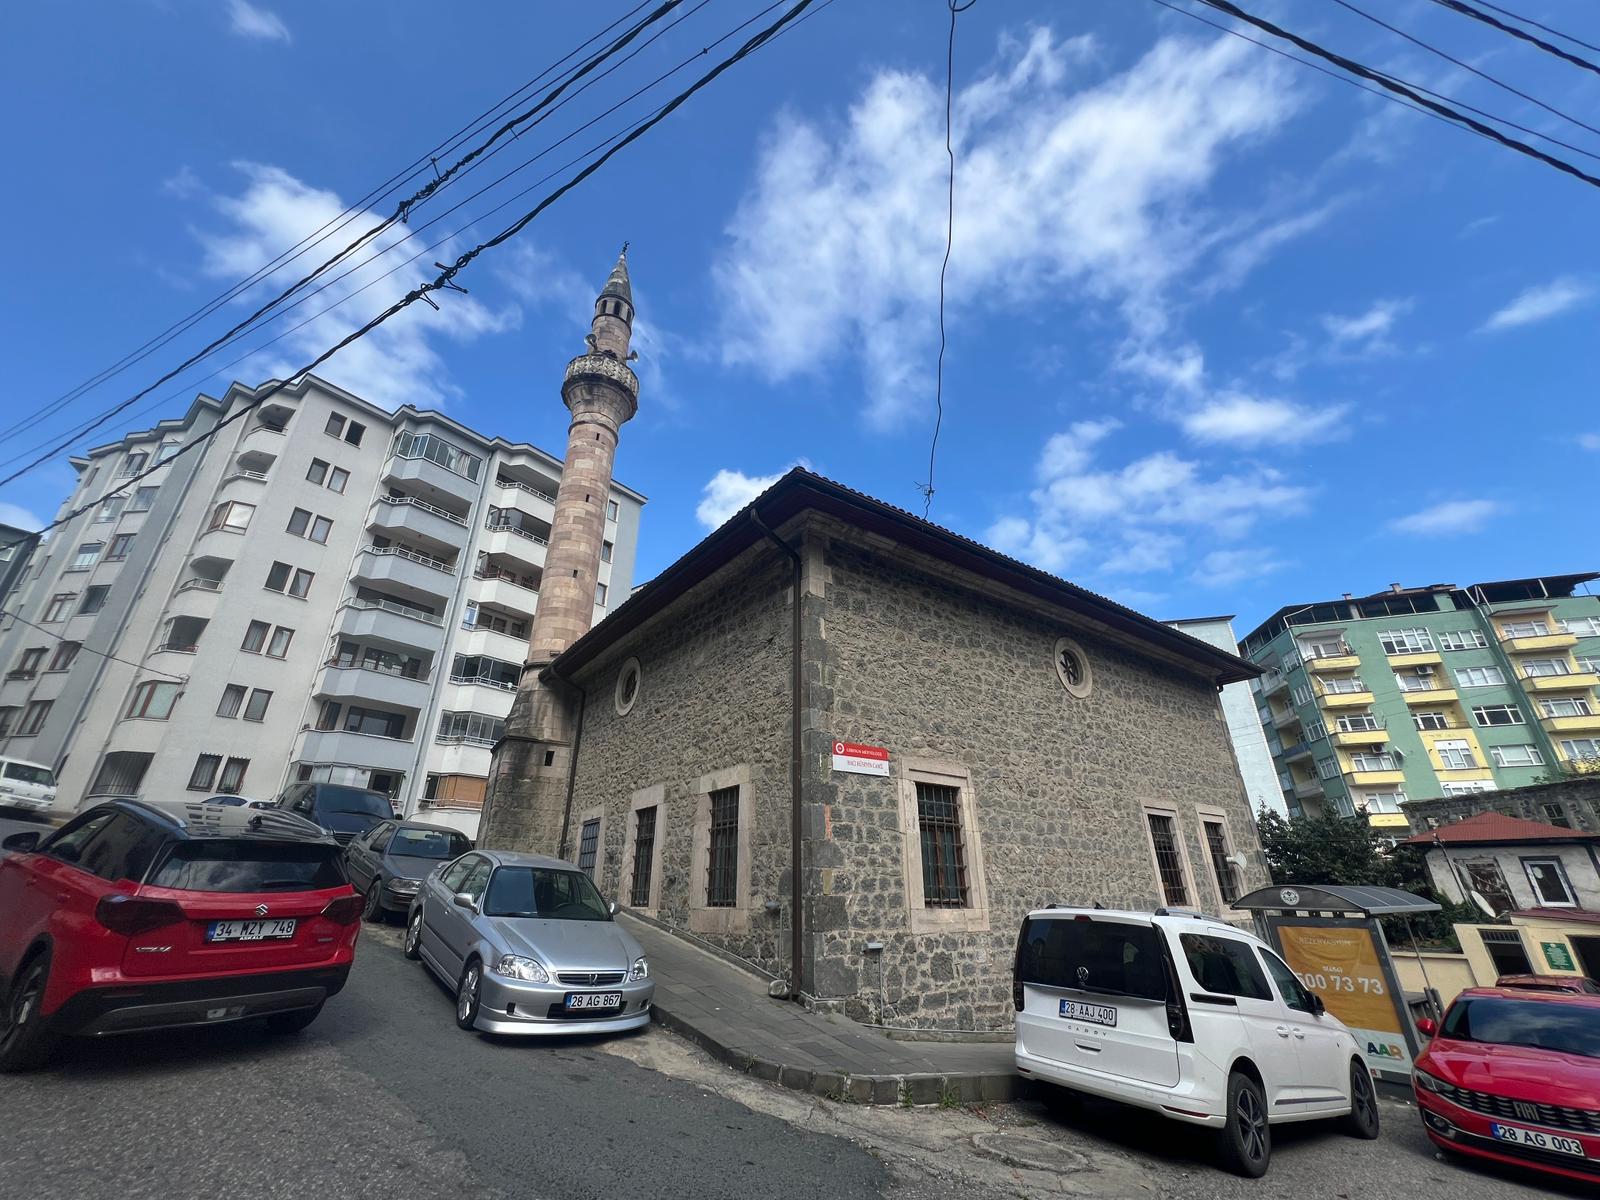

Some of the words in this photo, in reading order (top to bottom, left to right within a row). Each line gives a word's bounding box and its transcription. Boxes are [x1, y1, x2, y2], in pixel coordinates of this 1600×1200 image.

[216, 923, 232, 936] 34
[240, 922, 265, 935] MZY
[271, 921, 294, 934] 748
[1330, 975, 1355, 992] 73
[1357, 977, 1384, 995] 73
[571, 996, 583, 1007] 28
[586, 996, 600, 1006] AG
[603, 995, 620, 1006] 867
[1065, 1003, 1075, 1014] 28
[1080, 1005, 1095, 1017] AAJ
[1098, 1008, 1114, 1020] 400
[1513, 1101, 1540, 1120] FIAT
[1499, 1126, 1518, 1141] 28
[1524, 1131, 1546, 1146] AG
[1551, 1136, 1582, 1154] 003
